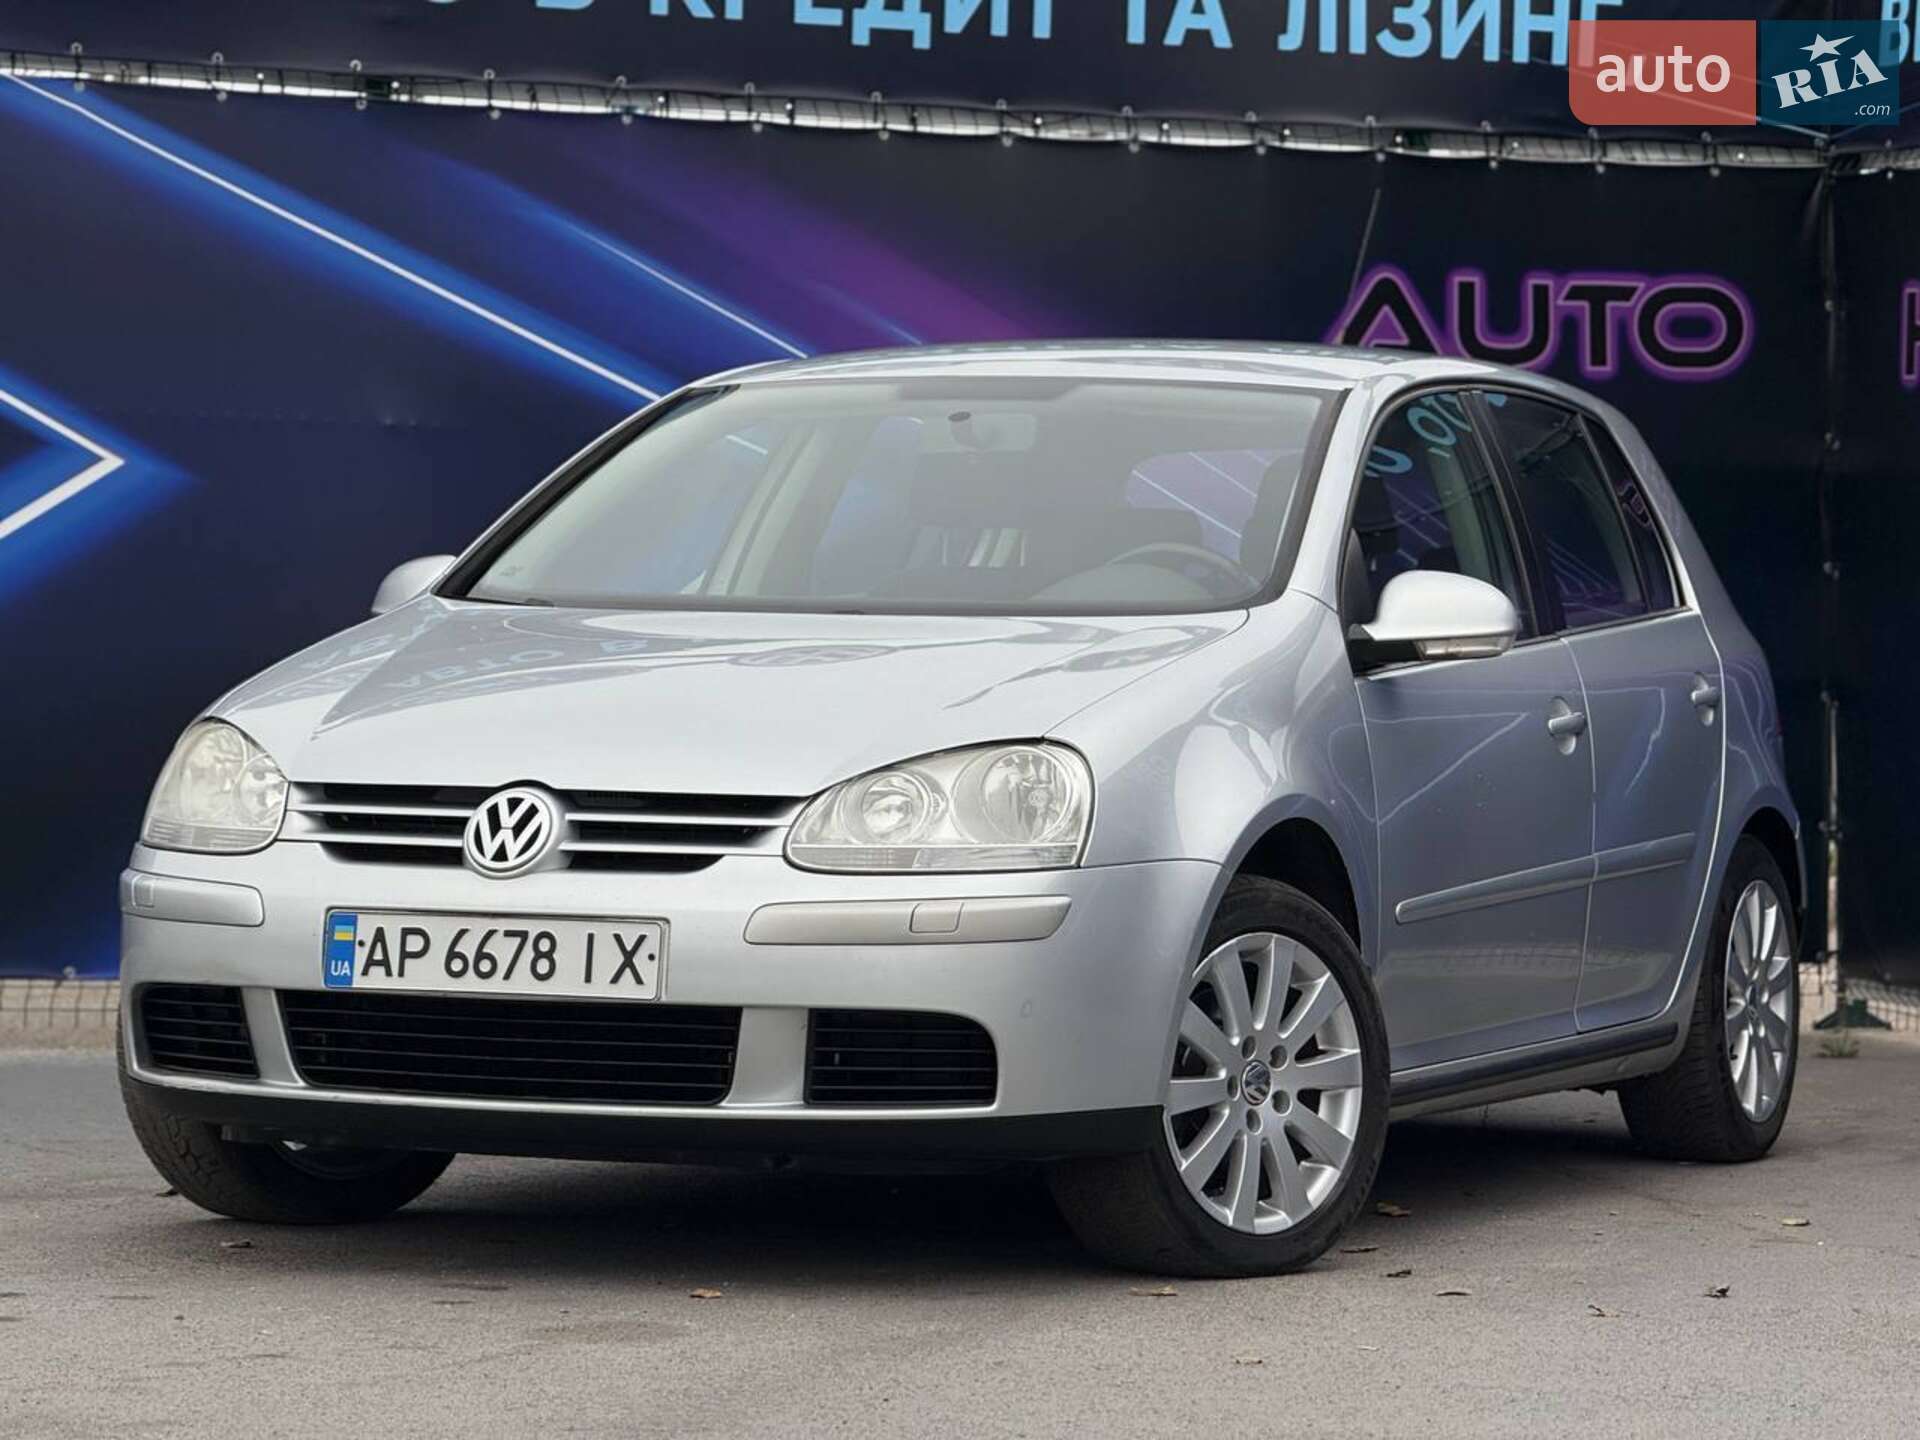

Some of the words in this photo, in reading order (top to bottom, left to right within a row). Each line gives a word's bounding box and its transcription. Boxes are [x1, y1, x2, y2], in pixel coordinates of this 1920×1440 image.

[1338, 272, 1746, 371] AUTO
[330, 960, 351, 976] UA
[445, 928, 557, 982] 6678
